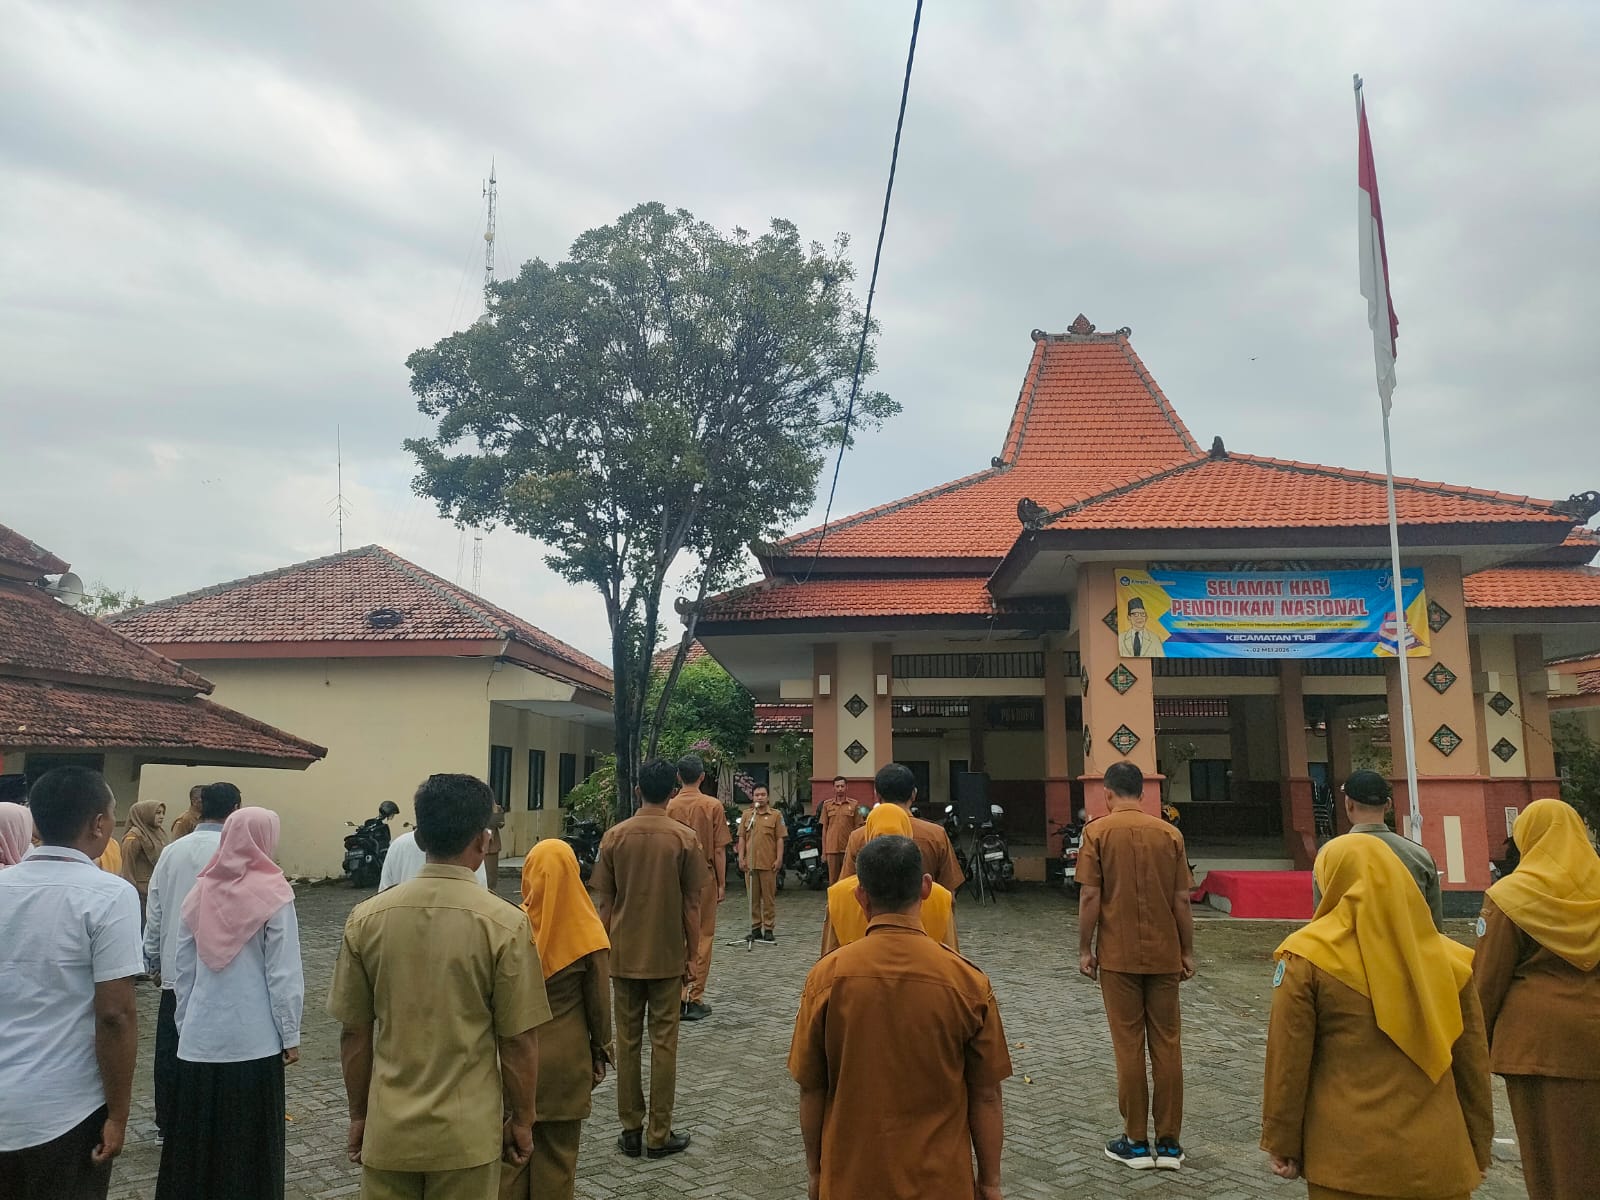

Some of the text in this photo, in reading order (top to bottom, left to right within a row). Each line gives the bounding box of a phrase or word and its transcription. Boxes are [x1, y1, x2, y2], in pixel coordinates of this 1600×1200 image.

[1207, 580, 1330, 596] SELAMAT HARI
[1171, 599, 1368, 616] PENDIDIKAN NASIONAL
